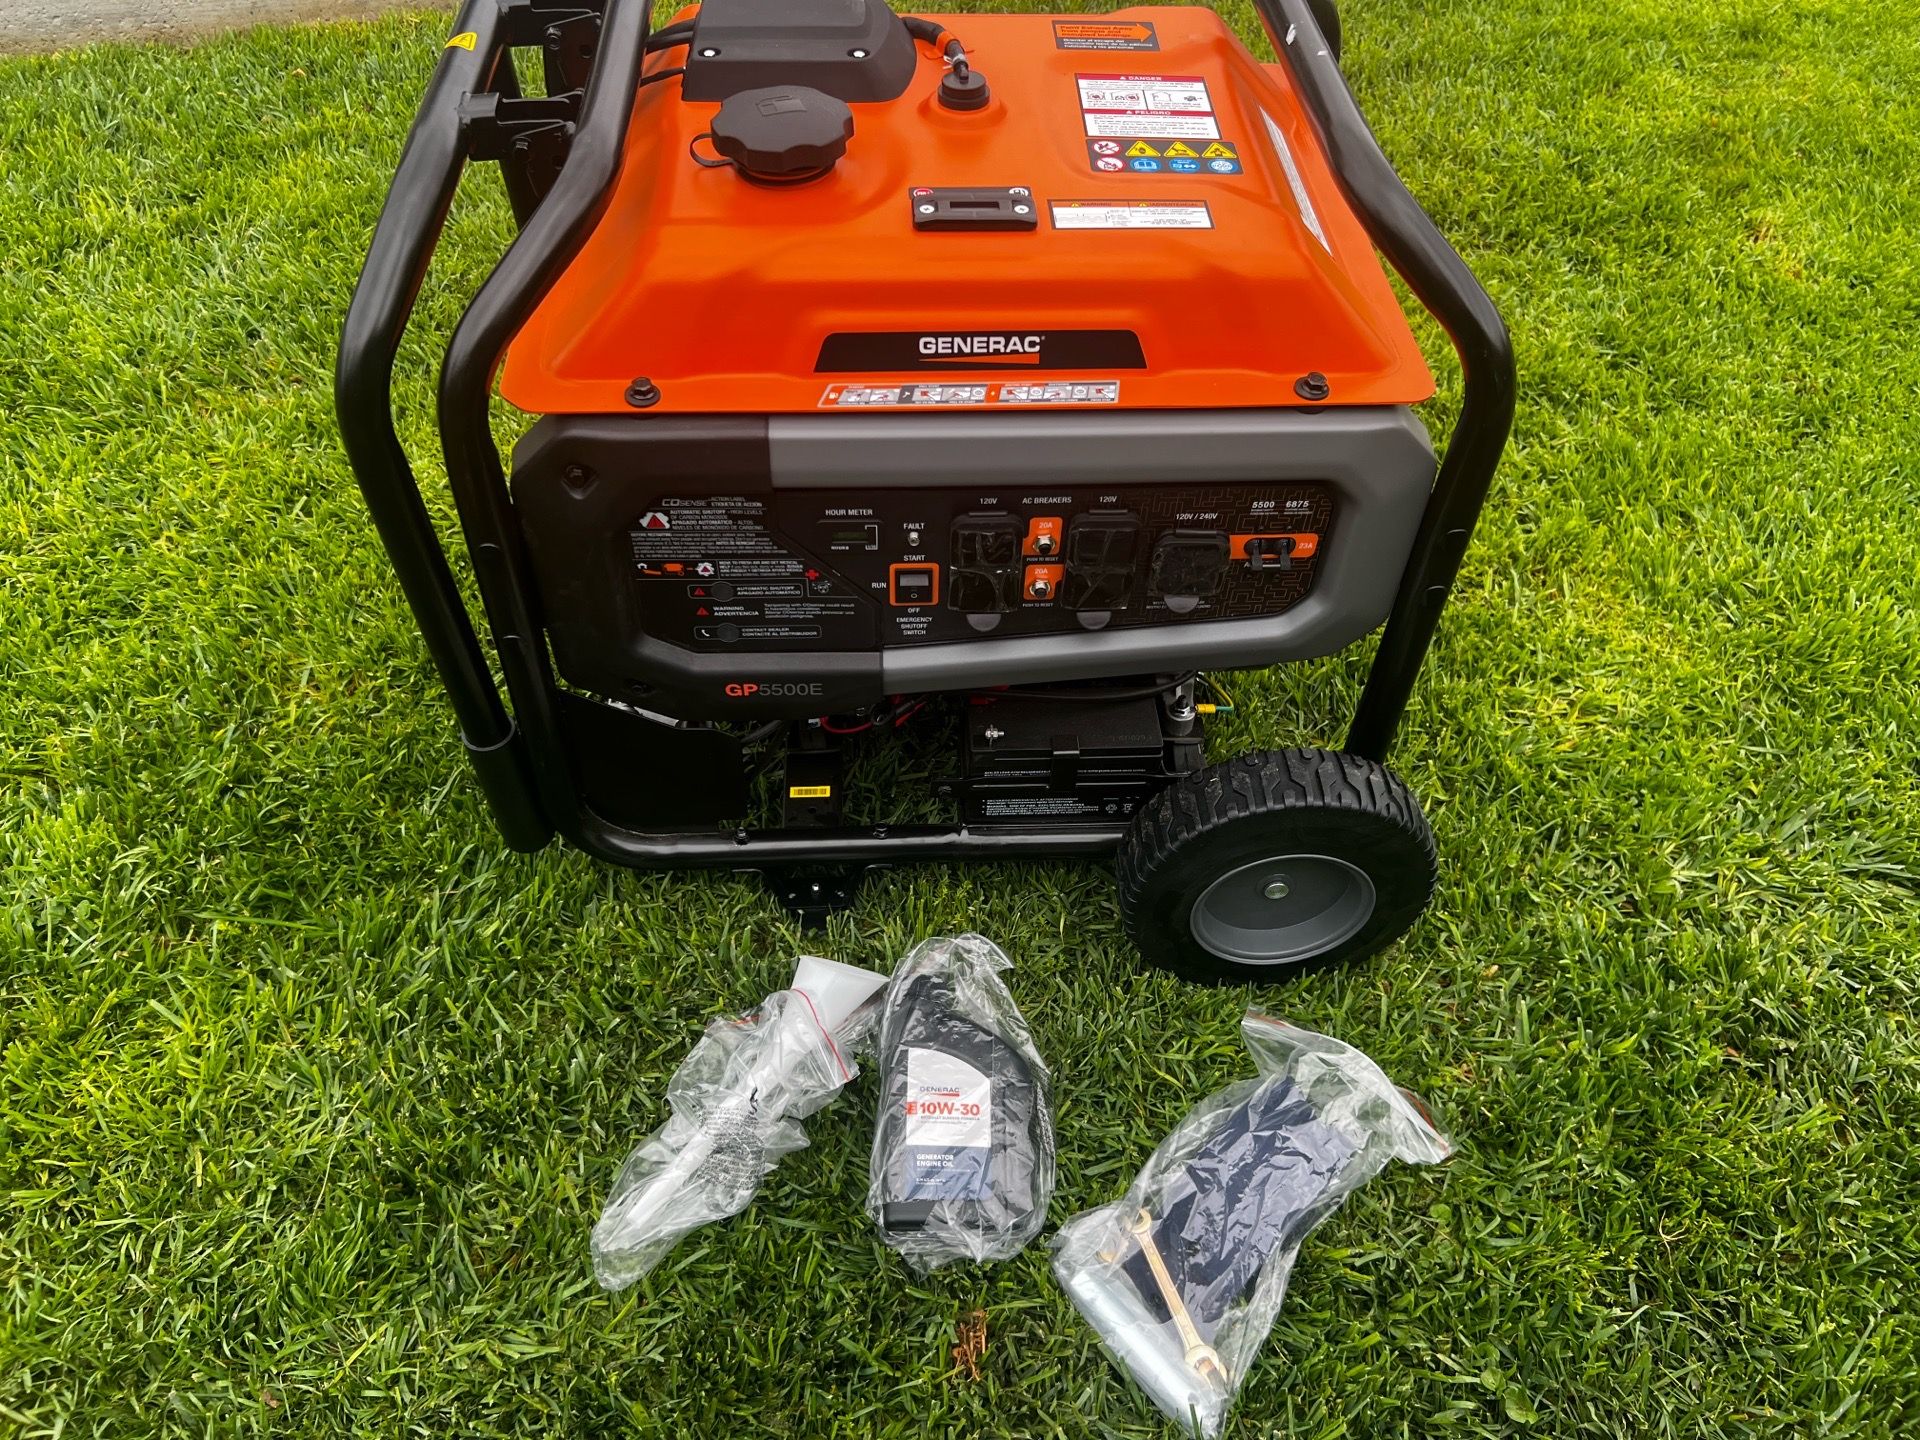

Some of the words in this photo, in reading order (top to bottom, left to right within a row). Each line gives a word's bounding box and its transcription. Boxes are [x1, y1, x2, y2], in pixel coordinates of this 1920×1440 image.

[919, 336, 1040, 354] GENERAC
[1099, 495, 1117, 503] 120V
[1252, 501, 1275, 509] 5500
[1286, 500, 1309, 508] 6875
[1199, 512, 1218, 520] 240V
[725, 683, 824, 697] GP5500E
[920, 1102, 980, 1116] 10W-30
[917, 1153, 954, 1161] GENERATOR
